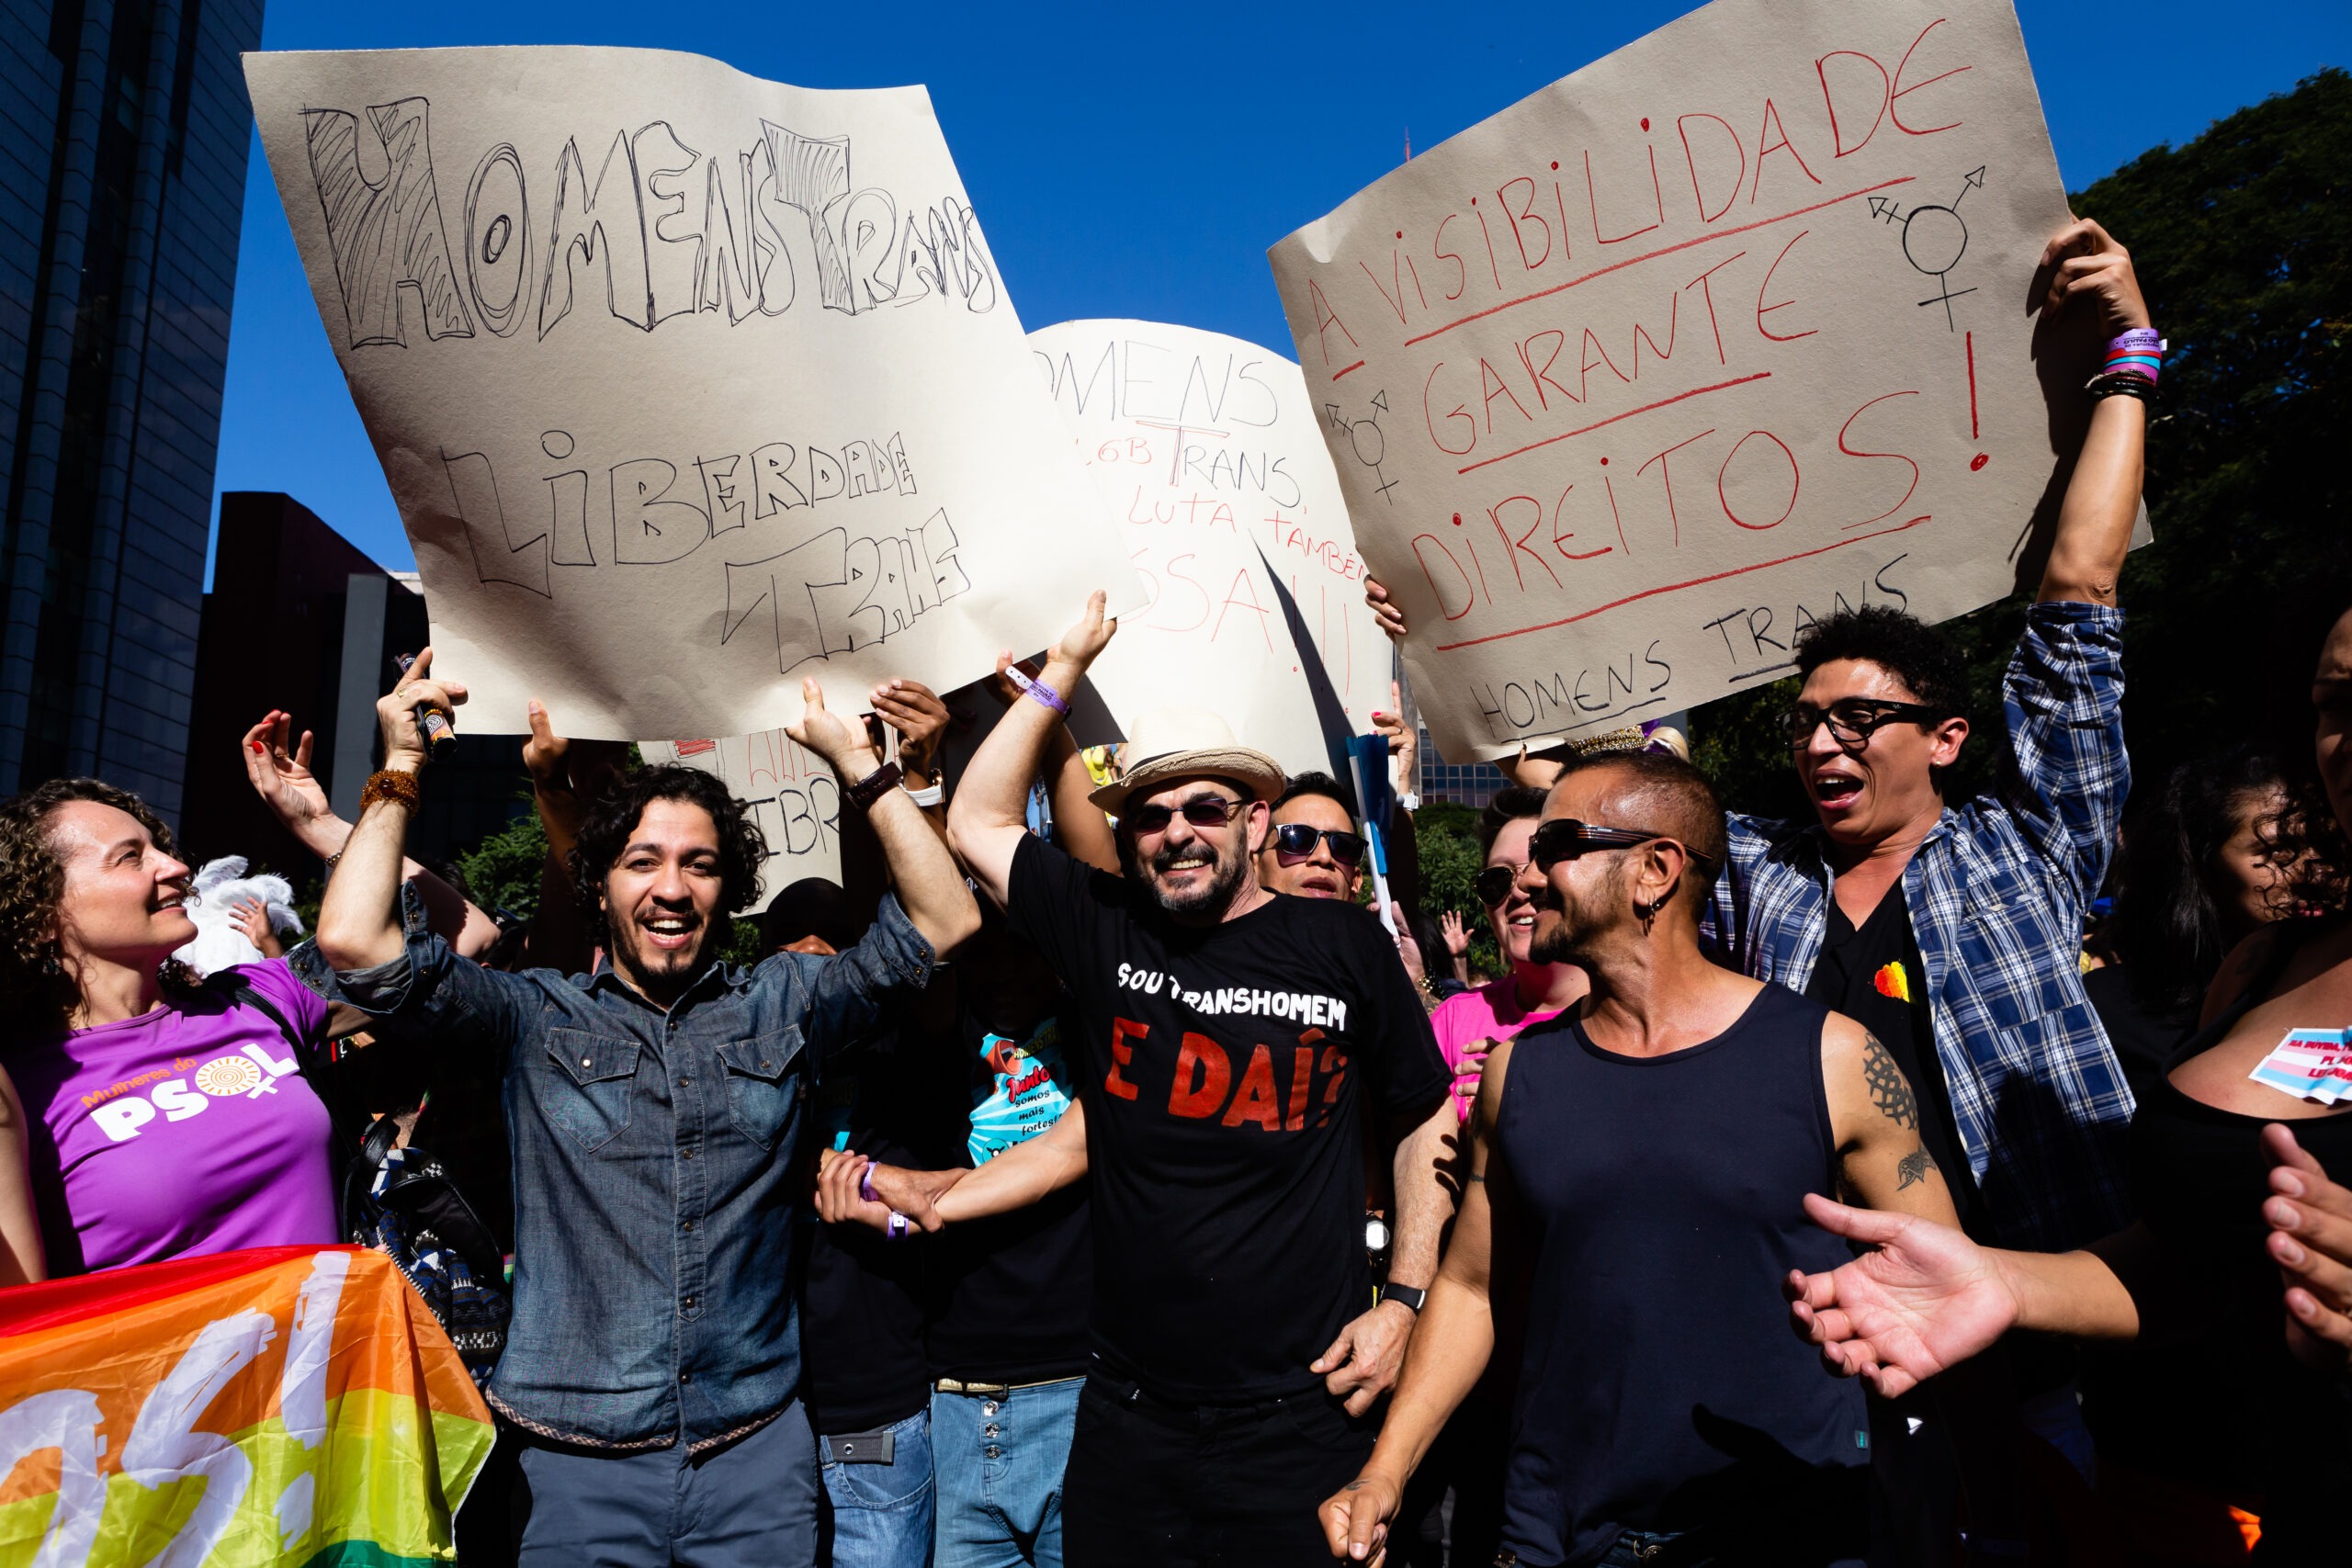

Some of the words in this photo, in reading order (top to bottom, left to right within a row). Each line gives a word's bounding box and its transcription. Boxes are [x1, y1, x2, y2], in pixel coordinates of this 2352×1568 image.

[299, 96, 795, 349] HOMENS
[759, 118, 996, 316] TRANS
[1309, 278, 1359, 366] A
[1425, 231, 1819, 455] GARANTE
[1129, 485, 1237, 533] LUTA
[721, 507, 971, 674] TRANS
[1471, 639, 1671, 735] HOMENS
[1118, 963, 1163, 994] SOU
[1169, 975, 1347, 1032] TRANSHOMEM
[81, 1066, 173, 1108] Mulheres
[174, 1056, 198, 1073] do
[90, 1043, 300, 1143] PSOL
[1006, 1062, 1056, 1103] Junto
[1015, 1089, 1050, 1108] somos
[1019, 1106, 1045, 1122] mais
[1104, 1016, 1150, 1101] E
[1168, 1027, 1348, 1132] DAÍ?
